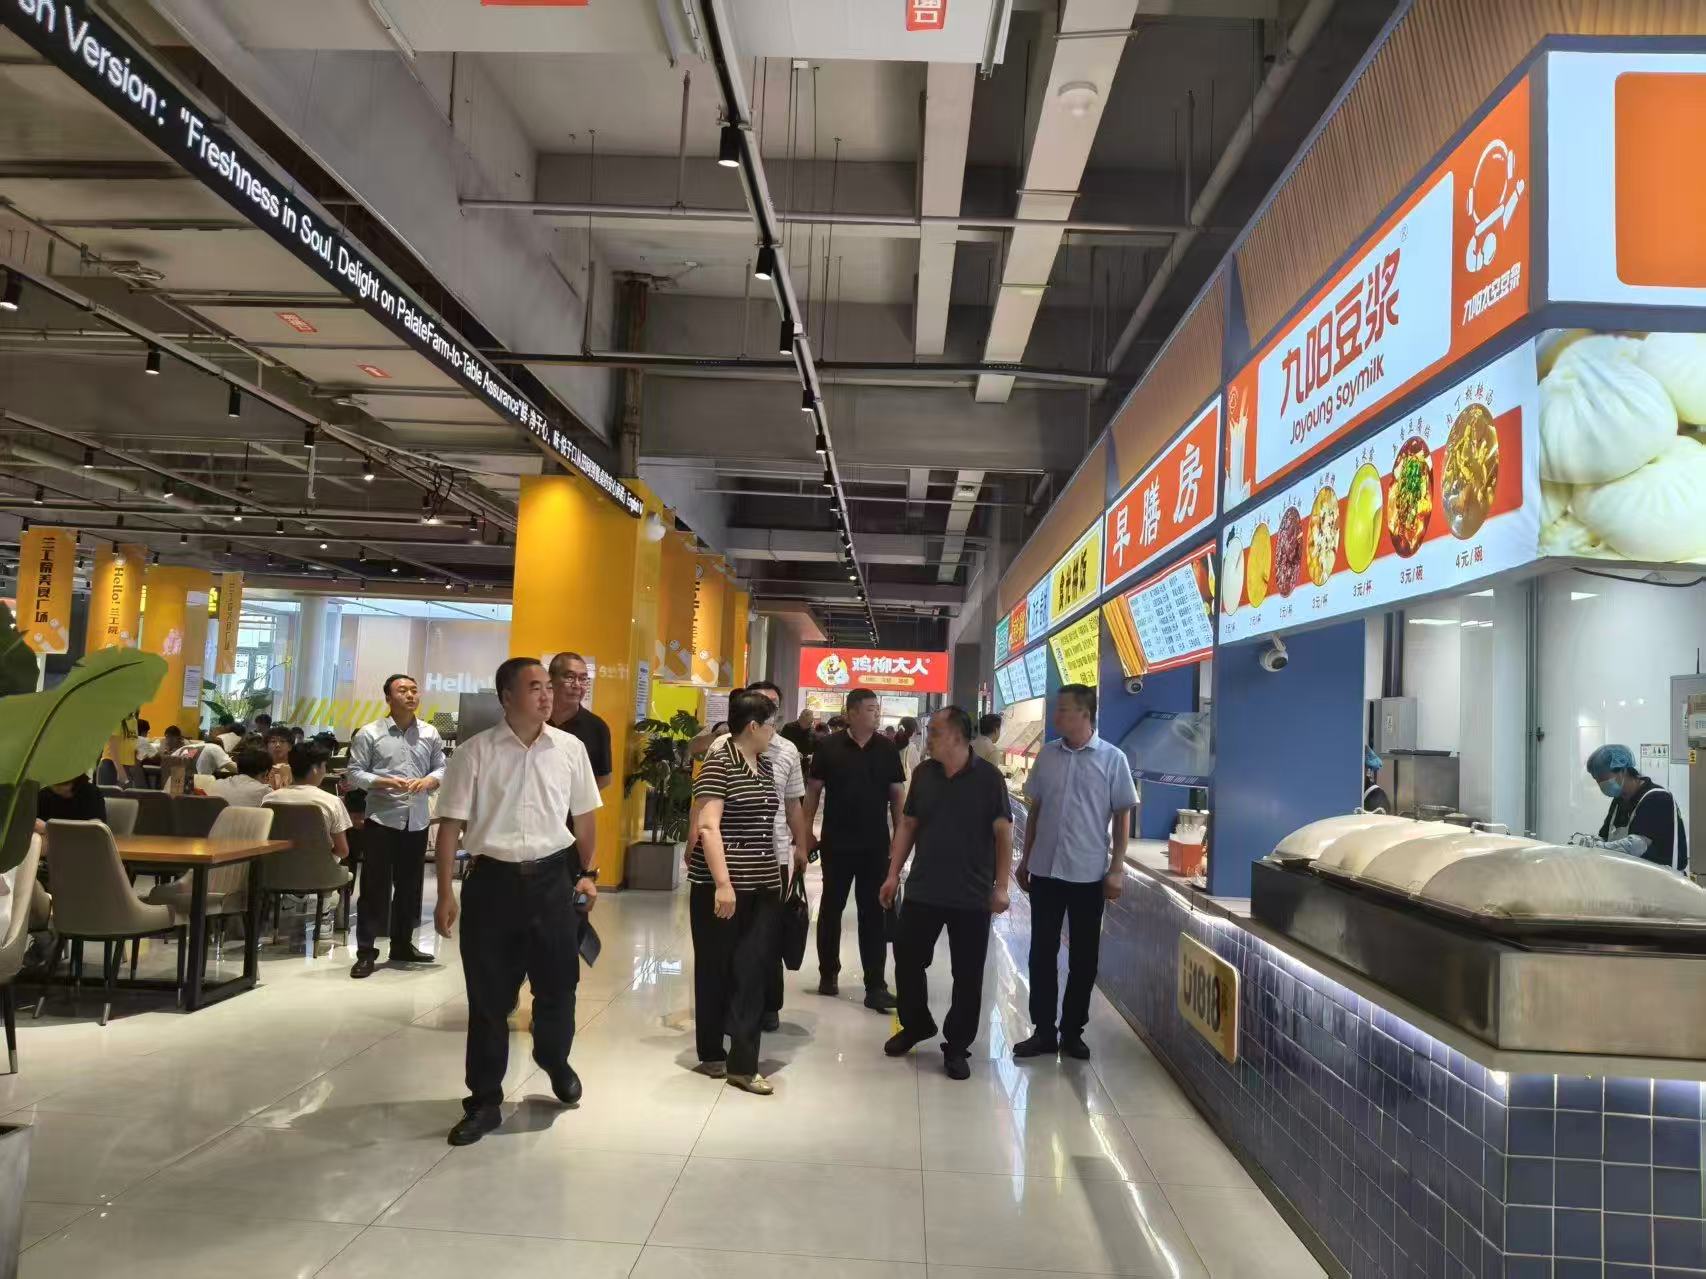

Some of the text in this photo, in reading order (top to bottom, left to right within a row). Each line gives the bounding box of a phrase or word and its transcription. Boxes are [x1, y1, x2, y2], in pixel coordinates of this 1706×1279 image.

[64, 5, 167, 126] Version:
[282, 198, 297, 233] in
[299, 214, 334, 270] Soul,
[337, 245, 379, 299] Delight
[381, 289, 395, 316] on
[1280, 247, 1401, 419] 九阳豆浆
[1112, 443, 1203, 568] 早膳房
[1400, 564, 1424, 584] 3元/碗
[1456, 544, 1484, 568] 4元/碗
[111, 567, 124, 604] Hello!
[851, 654, 929, 676] 鸡柳大人
